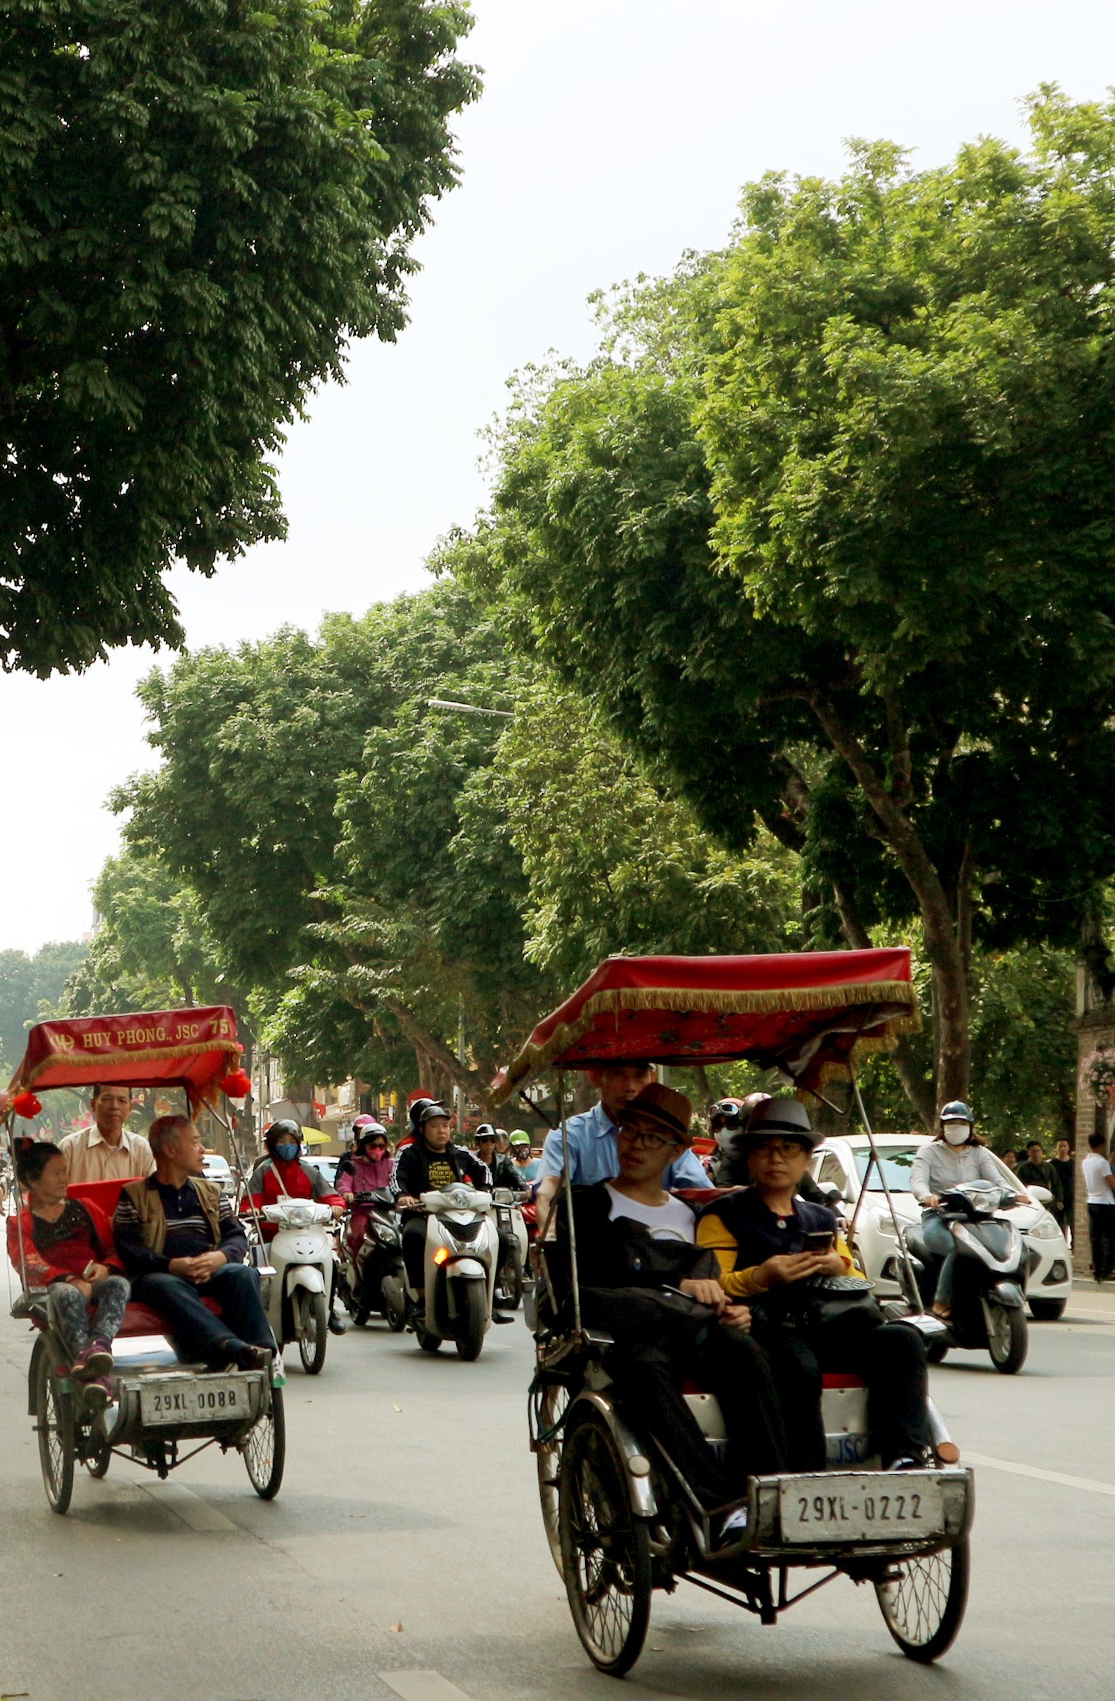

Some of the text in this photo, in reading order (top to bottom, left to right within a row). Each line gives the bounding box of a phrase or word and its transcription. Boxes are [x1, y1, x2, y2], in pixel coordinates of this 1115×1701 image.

[83, 1031, 112, 1049] HUY
[175, 1023, 199, 1040] JSC
[209, 1018, 230, 1036] 75
[797, 1494, 923, 1523] 29XL-0222
